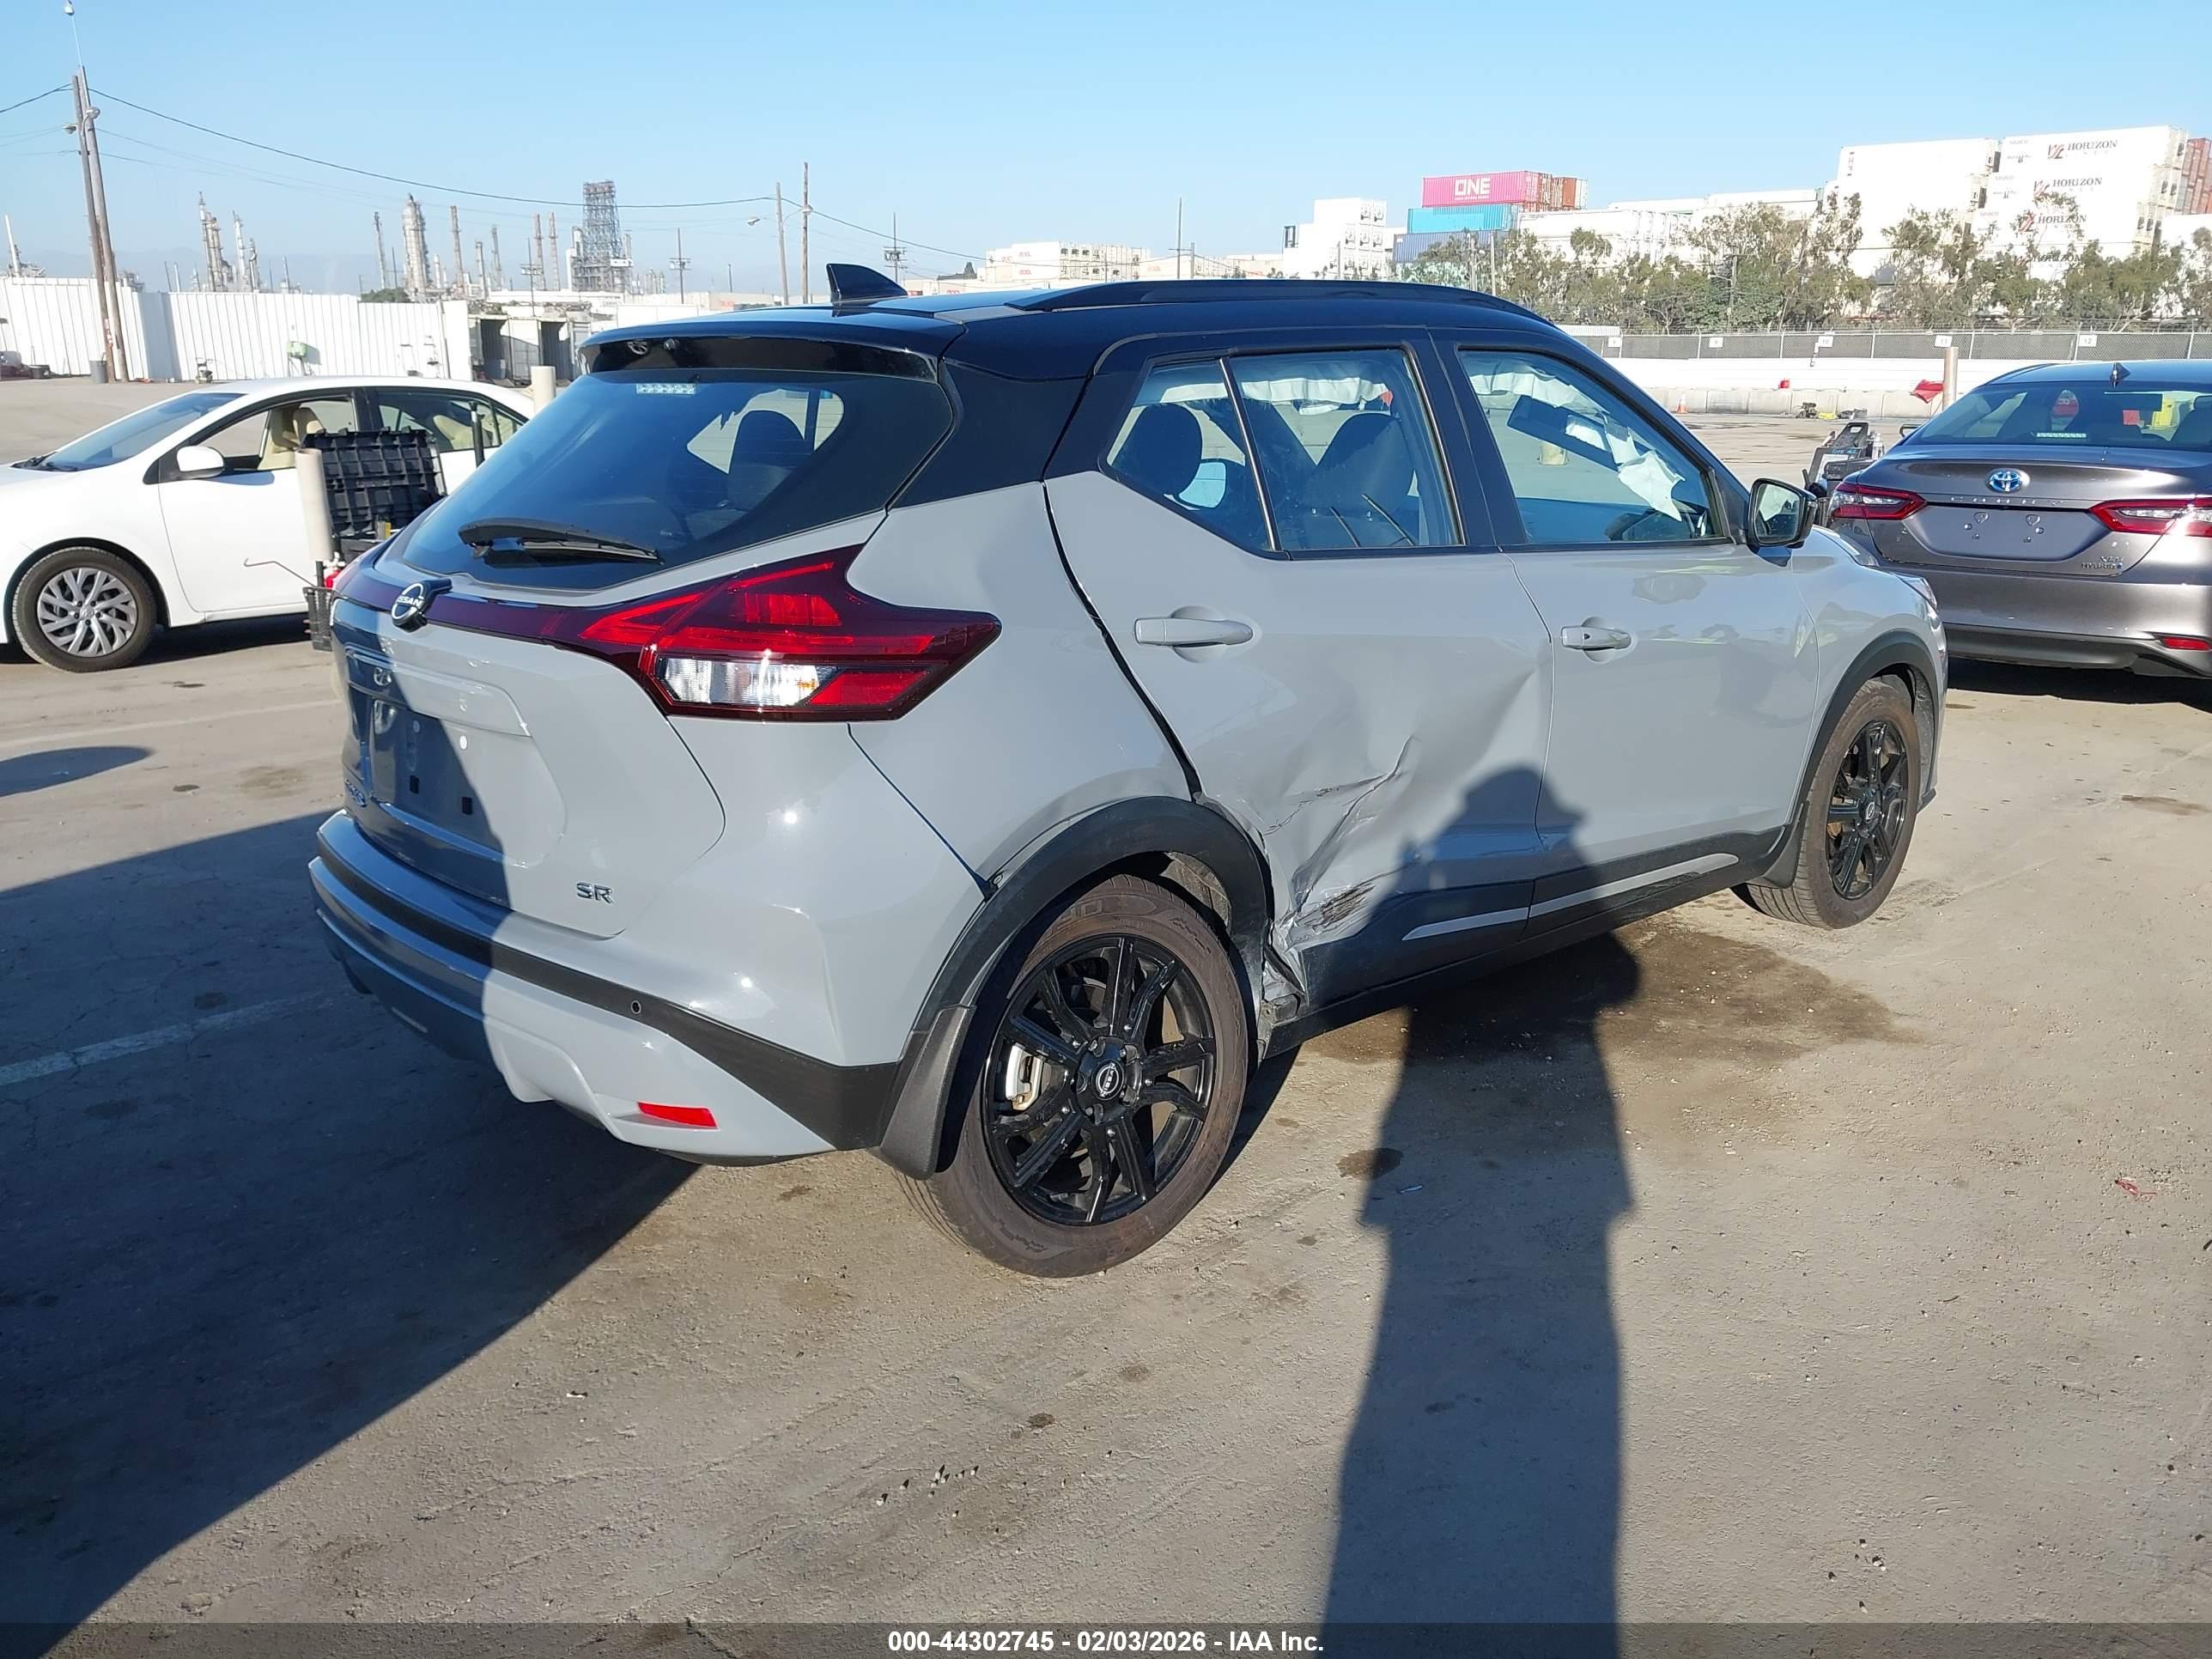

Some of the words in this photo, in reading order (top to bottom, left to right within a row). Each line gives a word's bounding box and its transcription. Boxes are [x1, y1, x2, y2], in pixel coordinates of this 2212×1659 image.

[2067, 140, 2118, 151] HORIZON
[1455, 178, 1490, 195] ONE
[2052, 178, 2102, 187] HORIZON
[2038, 215, 2087, 224] HORIZON
[397, 595, 423, 610] ISSAN
[576, 881, 614, 904] SR
